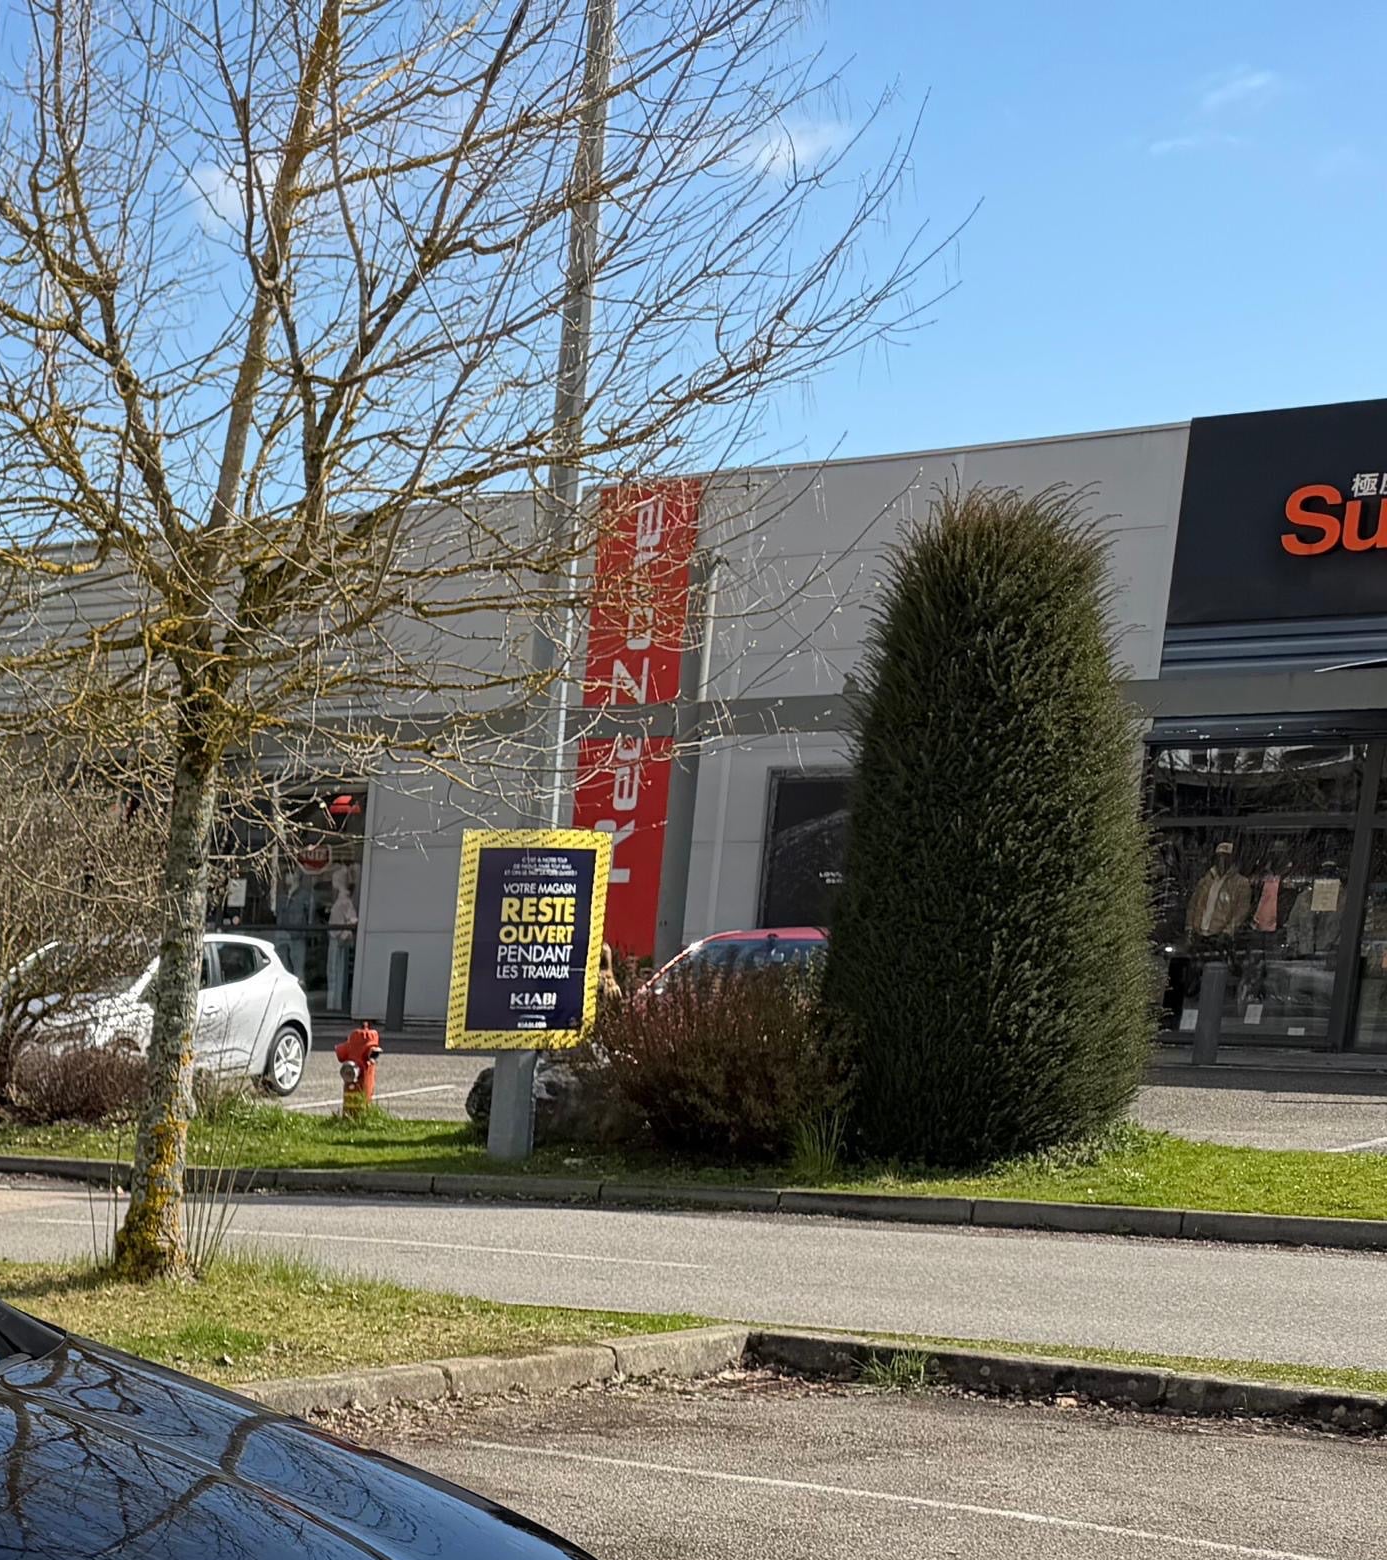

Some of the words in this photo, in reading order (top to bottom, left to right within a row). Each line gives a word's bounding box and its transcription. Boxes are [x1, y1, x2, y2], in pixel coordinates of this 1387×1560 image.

[1351, 473, 1387, 498] 極
[1281, 484, 1387, 555] Su
[503, 883, 536, 894] VOTRE
[538, 883, 577, 894] MAGASIN
[500, 896, 576, 923] RESTE
[499, 925, 575, 944] OUVERT
[497, 945, 573, 962] PENDANT
[496, 965, 518, 979] LES
[522, 965, 570, 979] TRAVAUX
[510, 992, 557, 1005] KIABI
